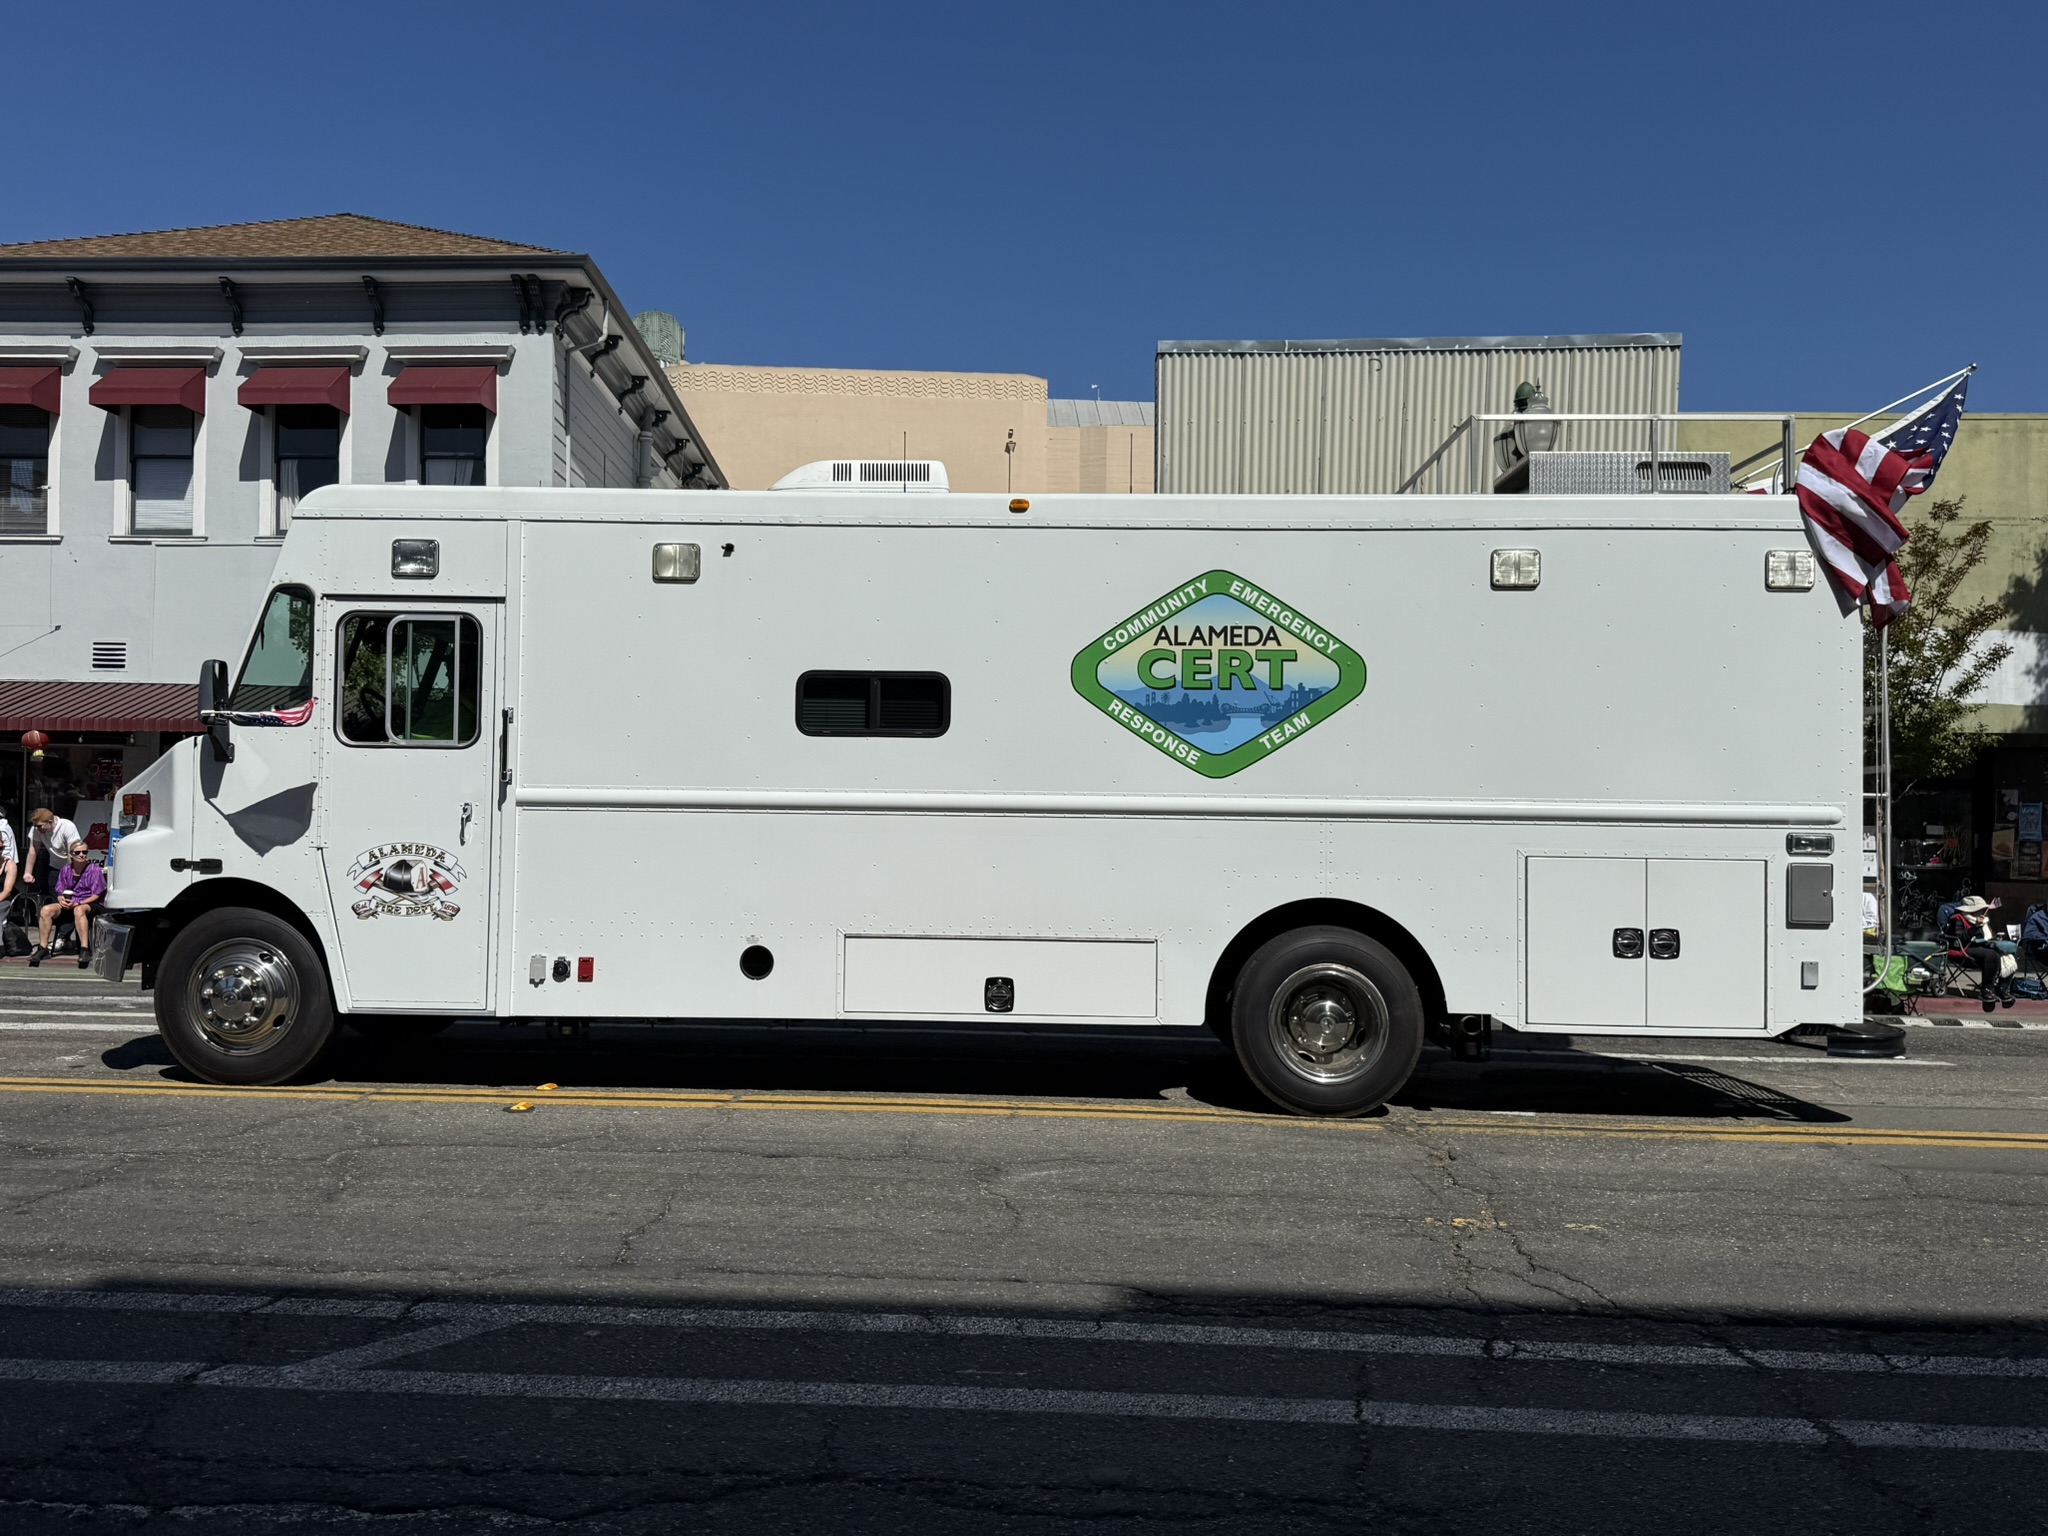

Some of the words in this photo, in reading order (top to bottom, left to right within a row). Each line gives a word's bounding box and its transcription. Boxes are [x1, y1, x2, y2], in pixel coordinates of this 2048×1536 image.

[1103, 578, 1209, 651] COMMUNITY
[1228, 579, 1341, 656] EMERGENCY
[1153, 625, 1282, 647] ALAMEDA
[1137, 648, 1298, 690] CERT
[1107, 698, 1201, 766] RESPONSE
[1258, 712, 1312, 750] TEAM
[368, 844, 446, 863] ALAMEDA
[375, 902, 402, 915] FIRE
